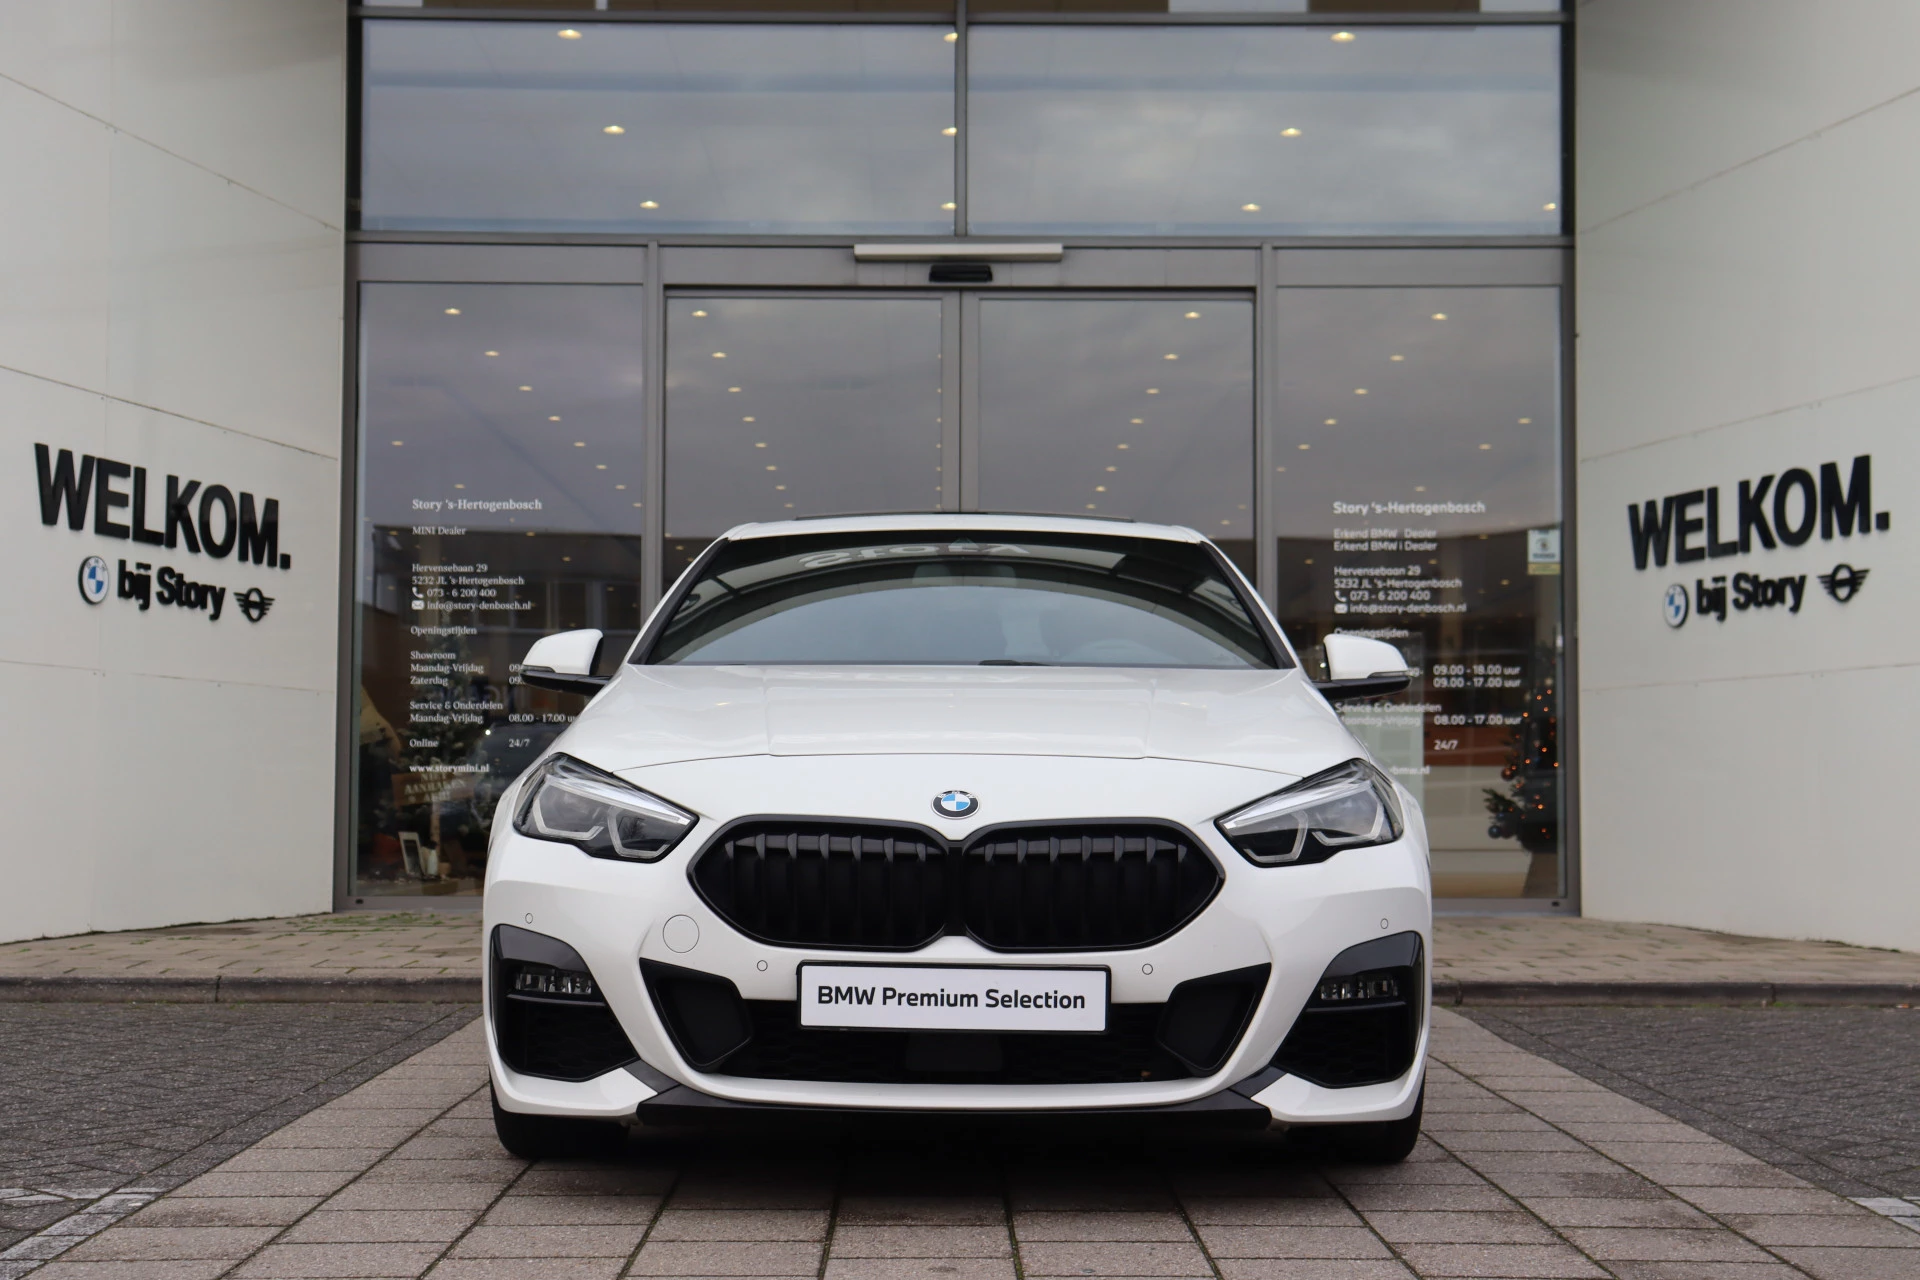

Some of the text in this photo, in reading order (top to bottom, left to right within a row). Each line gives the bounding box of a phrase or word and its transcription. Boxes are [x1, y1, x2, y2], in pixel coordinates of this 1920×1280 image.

[34, 443, 291, 569] WELKOM.
[412, 499, 442, 512] Story
[1333, 502, 1368, 515] Story
[1628, 455, 1890, 570] WELKOM.
[412, 526, 466, 535] MINI Dealer
[1333, 528, 1437, 538] Erkend BMW Dealer
[1334, 541, 1368, 551] Erkend
[1370, 541, 1398, 551] BMW
[1405, 541, 1437, 551] Dealer
[412, 563, 488, 573] Hervensebaan 29
[1334, 565, 1421, 576] Hervensebaan 29
[412, 576, 434, 585] 5232
[1334, 578, 1359, 588] 5232
[1361, 578, 1372, 589] JL
[117, 558, 226, 621] bij Story
[426, 588, 445, 597] 073
[452, 588, 458, 597] 6
[460, 588, 477, 597] 200
[479, 588, 497, 597] 400
[1350, 590, 1369, 600] 073
[1378, 590, 1386, 600] 6
[1387, 590, 1408, 600] 200
[1410, 590, 1430, 600] 400
[1696, 572, 1807, 622] bij Story
[427, 600, 531, 612] info@story-denbosch.nl
[1350, 603, 1467, 615] info@story-denbosch.nl
[410, 625, 477, 637] Openingstijden
[410, 650, 456, 660] Showroom
[410, 662, 485, 673] Maandag-Vrijdag
[1433, 664, 1464, 675] 09.00
[1472, 664, 1502, 675] 18.00
[1503, 667, 1521, 675] uur
[410, 675, 449, 686] Zaterdag
[1433, 677, 1464, 688] 09.00
[1504, 680, 1521, 688] uur
[410, 701, 503, 710] Service & Onderdelen
[1334, 702, 1442, 713] Service & Onderdelen
[410, 713, 483, 724] Maandag-Vrijdag
[508, 713, 534, 722] 08.00
[542, 713, 566, 722] 17.00
[1434, 715, 1466, 725] 08.00
[409, 738, 530, 748] Online 24/7
[1434, 740, 1458, 750] 24/7
[409, 763, 490, 773] www.storymini.nl
[817, 985, 1086, 1009] BMW Premium Selection
